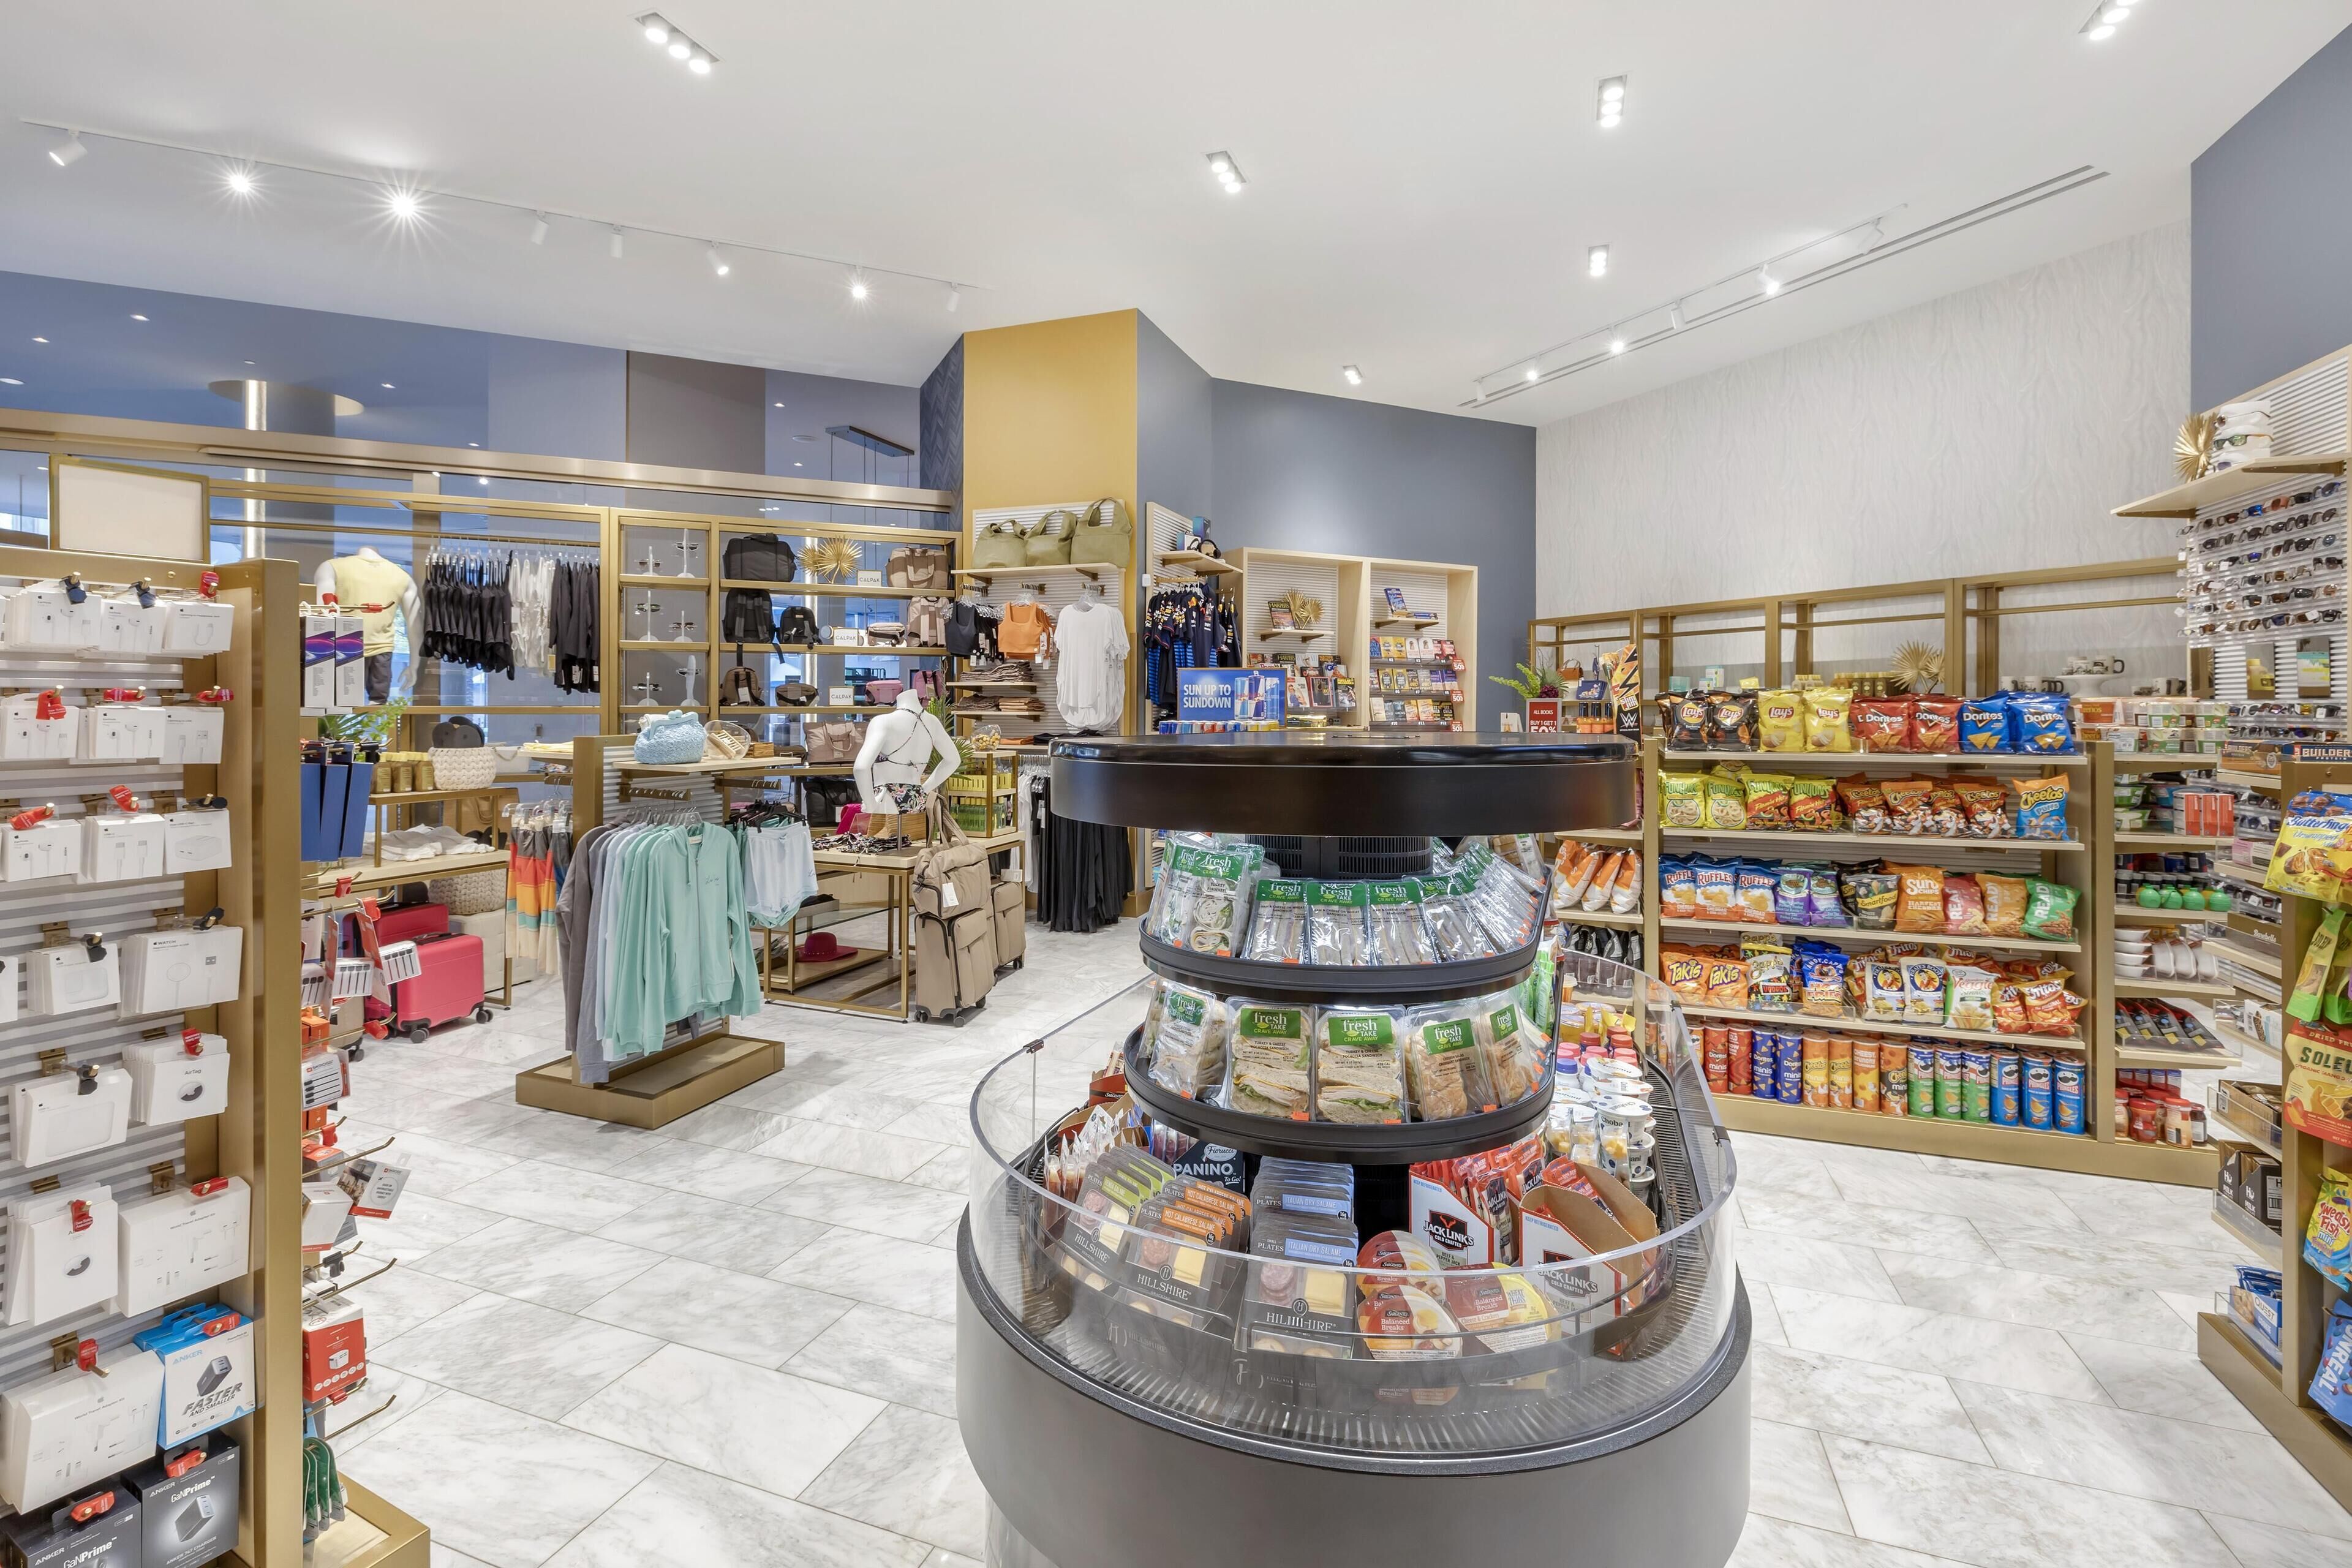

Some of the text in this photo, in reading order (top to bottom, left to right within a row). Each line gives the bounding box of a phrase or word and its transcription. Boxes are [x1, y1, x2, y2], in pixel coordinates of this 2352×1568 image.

[1183, 685, 1231, 696] SUN UP TO
[1183, 697, 1231, 708] SUNDOWN
[1866, 713, 1903, 723] Doritos
[1915, 712, 1951, 723] Doritos
[1962, 712, 2003, 722] Doritos
[2024, 713, 2064, 723] Doritos
[2302, 748, 2352, 758] BUILDER
[2021, 787, 2065, 810] Cheetos
[1666, 870, 1695, 884] RUFFLE
[1697, 870, 1733, 885] RUFFLES
[1270, 882, 1301, 892] fresh
[1321, 887, 1352, 897] fresh
[1375, 884, 1406, 894] fresh
[1906, 879, 1938, 895] Sun
[1860, 893, 1896, 908] Smartfood
[1668, 959, 1703, 984] Takis
[1709, 965, 1740, 989] Takis
[2025, 980, 2062, 999] Fritos
[1254, 1011, 1287, 1023] fresh
[1496, 1011, 1512, 1026] fresh
[1343, 1019, 1378, 1032] fresh
[1434, 1024, 1462, 1040] fresh
[1754, 1054, 1773, 1062] Doritos
[1601, 1115, 1630, 1128] Chobai
[1207, 1145, 1235, 1155] Fiorucci
[1173, 1163, 1234, 1175] PANINO
[1164, 1187, 1185, 1199] PLATES
[1196, 1192, 1219, 1206] CALABRESE
[1219, 1200, 1235, 1212] SALAME
[2245, 1199, 2256, 1213] MILK
[1141, 1208, 1162, 1219] PLATES
[1174, 1212, 1197, 1226] CALABRESE
[1199, 1220, 1216, 1232] SALAME
[2320, 1215, 2340, 1238] Fish
[1423, 1220, 1474, 1246] JACK LINK'S
[2318, 1231, 2335, 1246] mini
[1074, 1233, 1109, 1264] HILLSHIRE
[1434, 1234, 1463, 1248] COLD CRAFTED
[1257, 1242, 1343, 1256] PLATES ITALIAN DRY SALAME
[1436, 1254, 1450, 1263] PEPPER
[1137, 1273, 1189, 1300] HILLSHIRE
[1565, 1273, 1599, 1293] LINK'S
[1475, 1295, 1503, 1305] Balanced
[1477, 1303, 1498, 1311] Breaks
[2254, 1295, 2275, 1322] QUEST
[173, 1349, 203, 1365] ANKER
[182, 1382, 243, 1416] FASTER
[189, 1393, 236, 1418] AND SMALLER
[149, 1482, 175, 1498] ANKER
[35, 1547, 65, 1566] ANKER
[166, 1553, 184, 1565] ANKER
[193, 1536, 217, 1552] CHARGER
